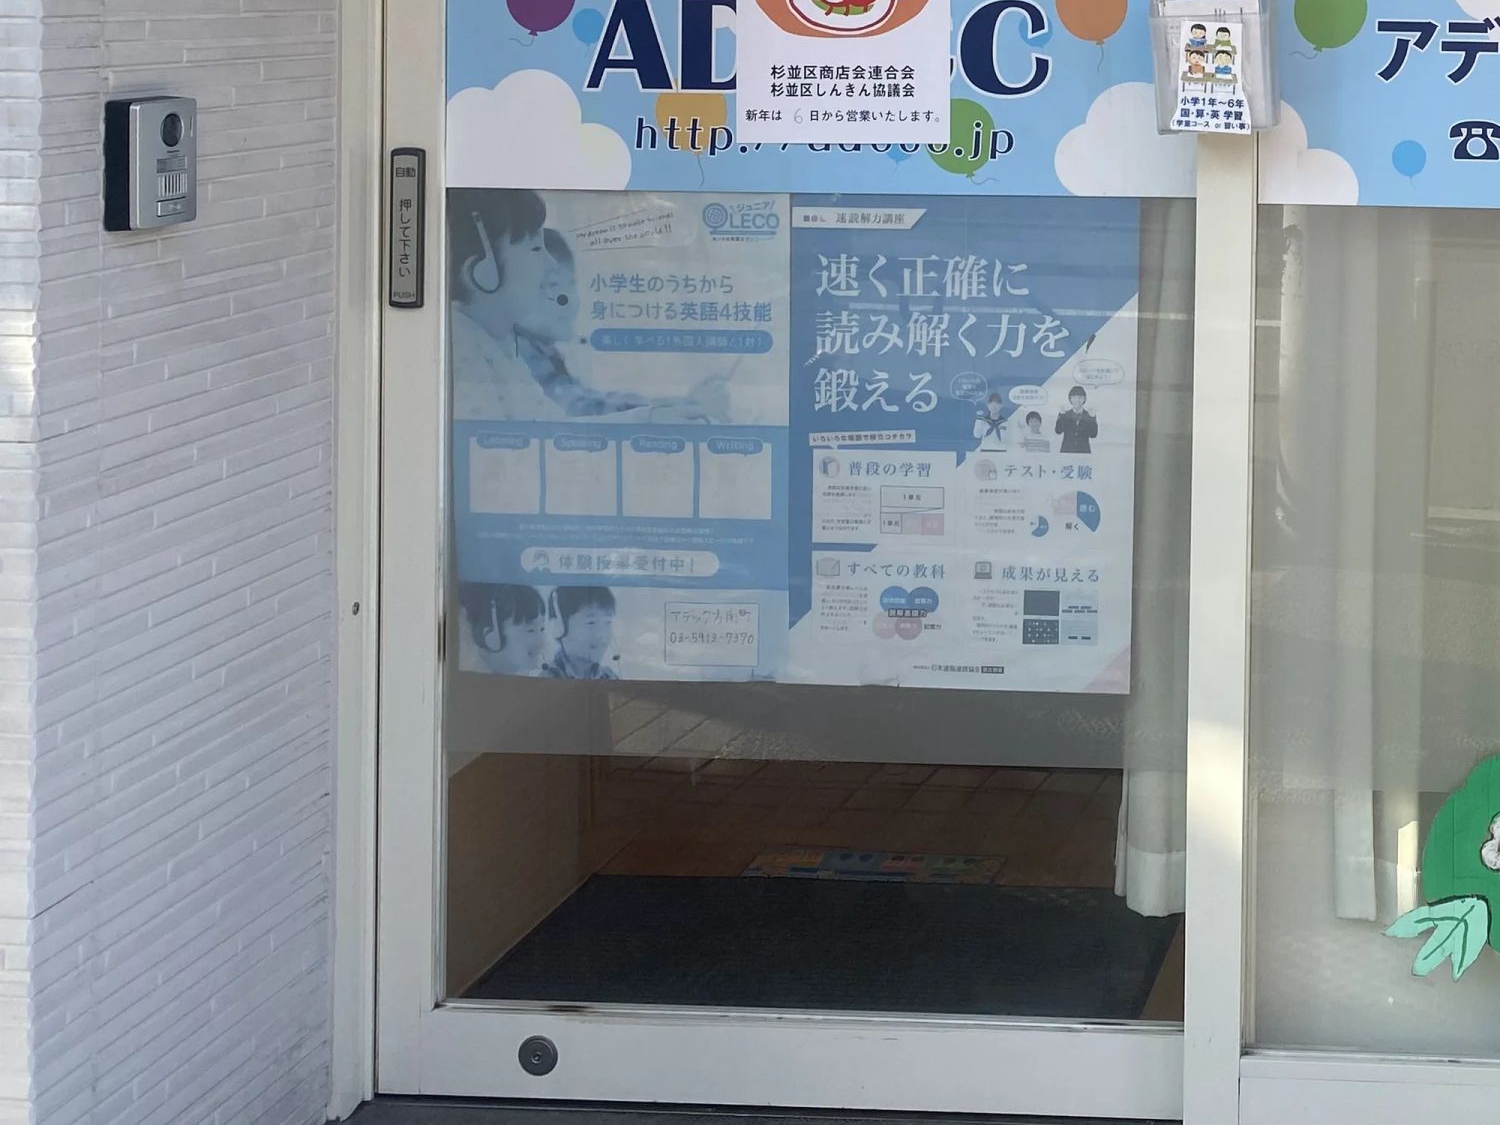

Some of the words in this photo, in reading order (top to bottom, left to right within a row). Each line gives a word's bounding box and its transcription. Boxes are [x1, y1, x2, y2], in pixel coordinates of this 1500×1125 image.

[770, 65, 916, 80] 杉並区商店会連合会
[770, 83, 916, 98] 杉並区しんきん協議会
[745, 109, 783, 122] 新年は
[809, 109, 940, 123] 日から営業いたします。
[395, 166, 417, 179] 自動
[729, 212, 780, 229] LECO
[835, 213, 906, 225] 速読解力講座
[399, 198, 413, 278] 押して下さい
[590, 274, 734, 294] 小学生のうちから
[815, 253, 1030, 300] 速く正確に
[393, 291, 416, 299] PUSH
[590, 301, 773, 323] 身につける英語4技能
[814, 310, 1071, 359] 読み解く力を
[814, 367, 939, 413] 鍛える
[716, 439, 755, 452] Writing
[849, 460, 931, 478] 普段の学習
[1004, 464, 1093, 481] テスト・受験
[847, 561, 945, 580] すべての教科
[1001, 565, 1099, 583] 成果が見える
